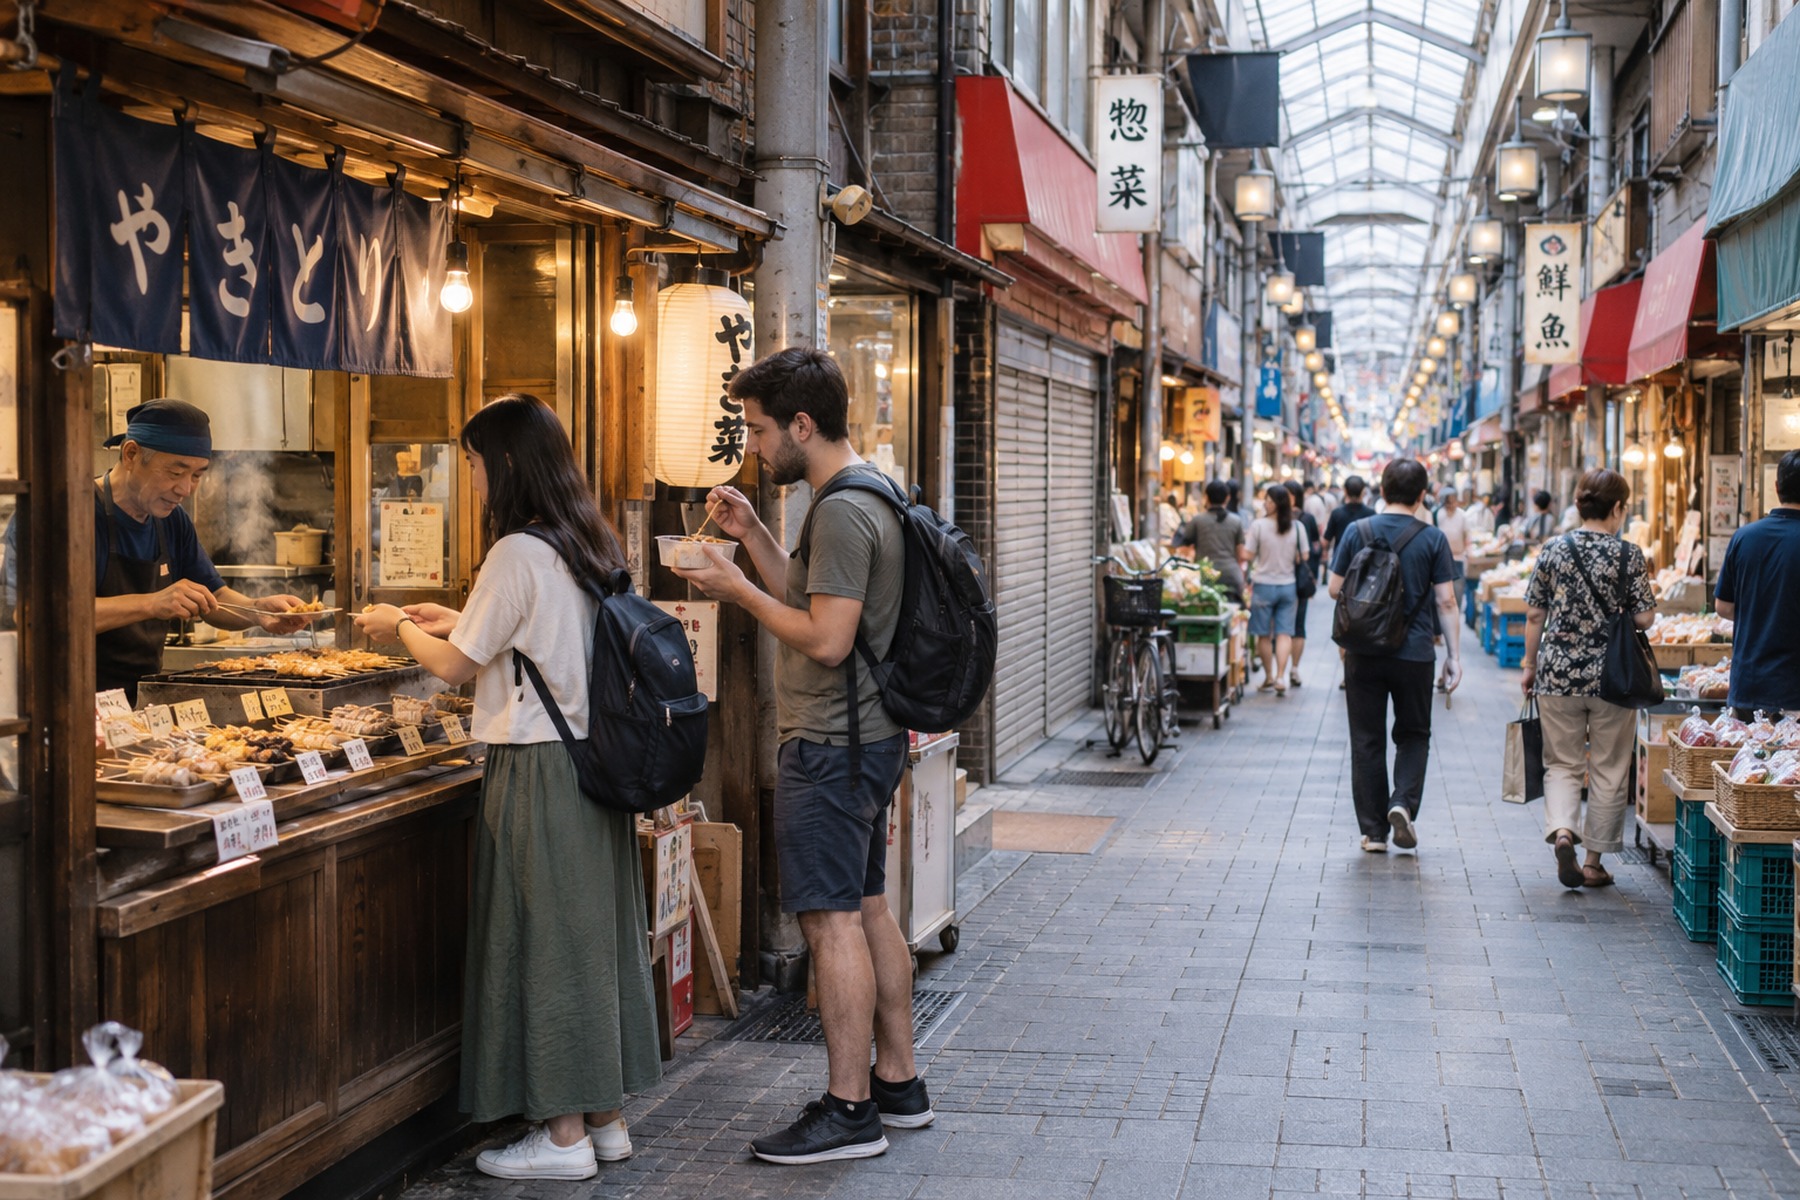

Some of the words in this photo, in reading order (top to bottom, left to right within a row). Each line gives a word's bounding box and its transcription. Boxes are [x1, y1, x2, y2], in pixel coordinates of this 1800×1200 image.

[1108, 97, 1148, 211] 惣菜
[109, 182, 382, 332] やきとり
[1535, 263, 1572, 350] 鮮魚
